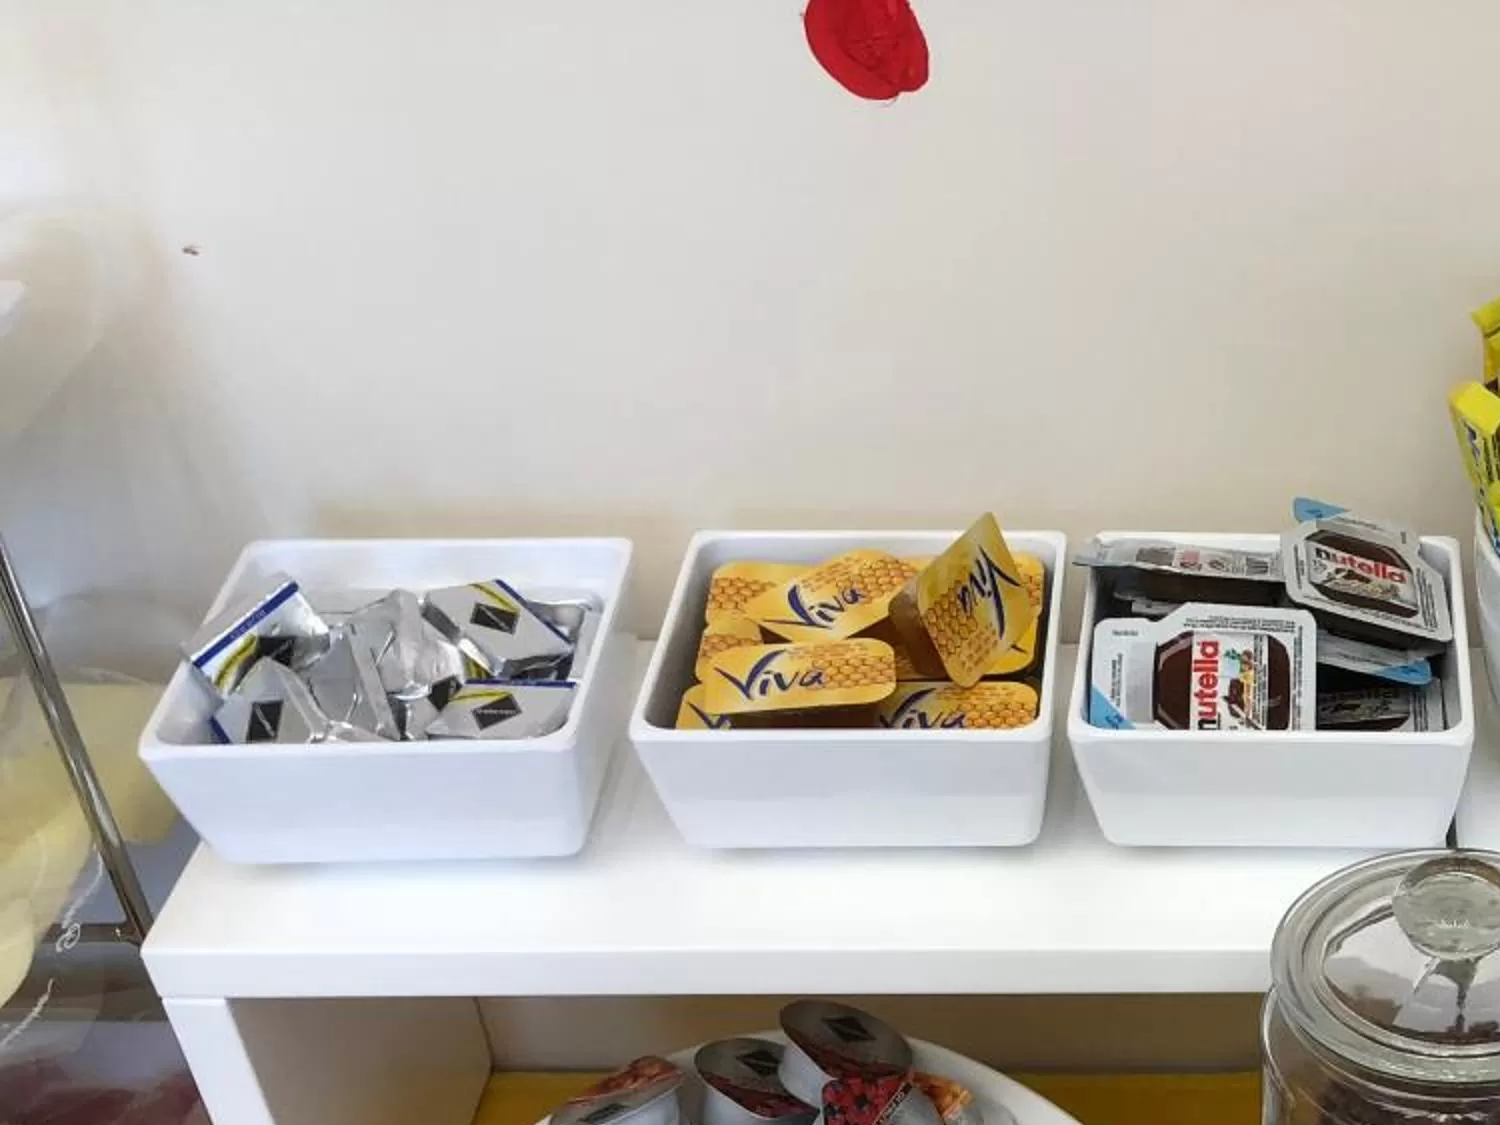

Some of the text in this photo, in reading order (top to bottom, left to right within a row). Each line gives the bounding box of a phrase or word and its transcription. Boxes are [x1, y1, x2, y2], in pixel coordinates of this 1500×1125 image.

[1315, 547, 1407, 584] nutella
[760, 583, 866, 630] Viva
[714, 649, 825, 701] Viva
[1193, 641, 1221, 730] nutella
